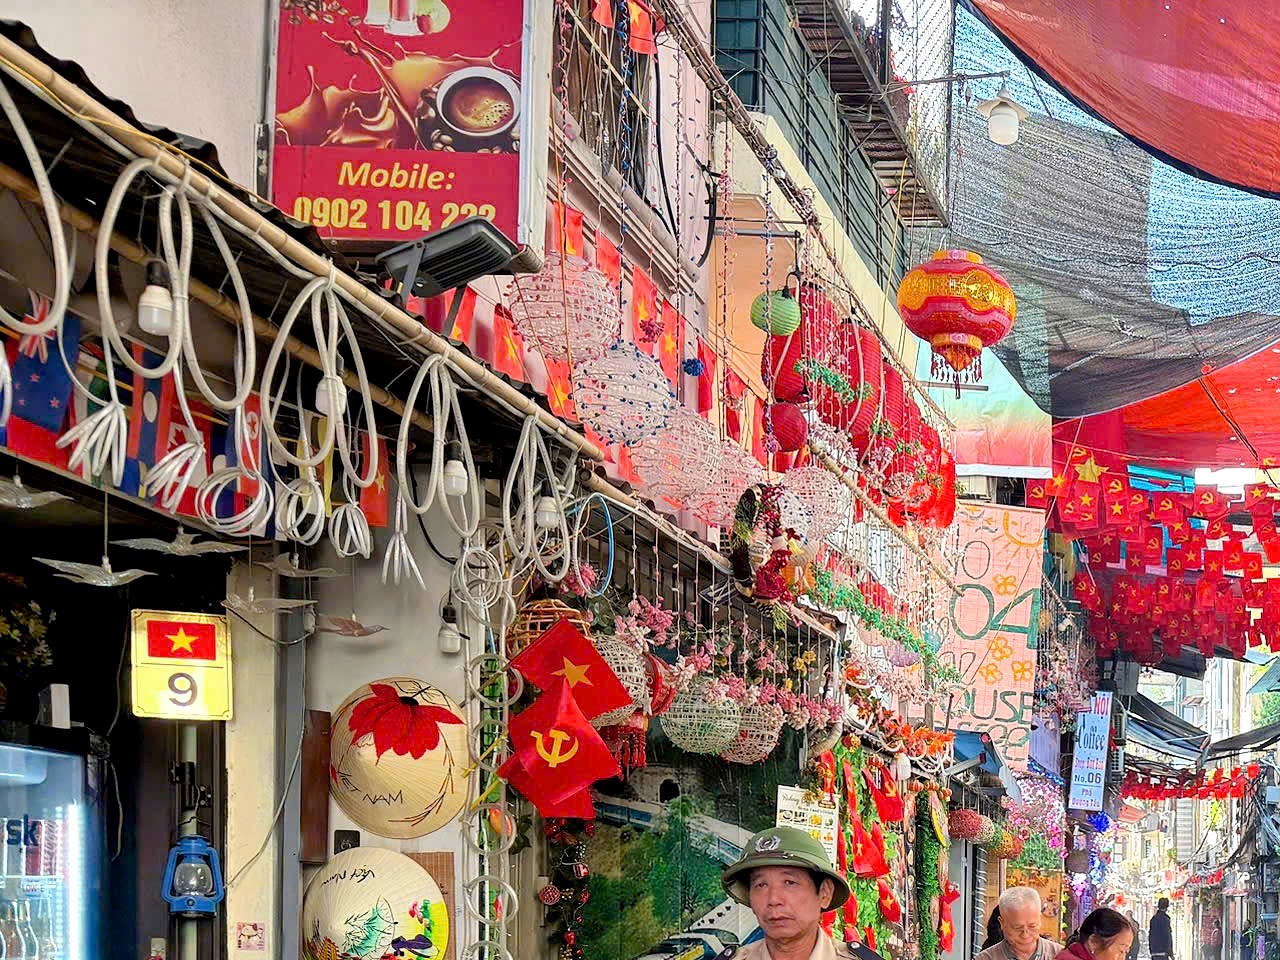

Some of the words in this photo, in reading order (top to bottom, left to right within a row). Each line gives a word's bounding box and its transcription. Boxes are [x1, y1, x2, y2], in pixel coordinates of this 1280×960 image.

[338, 162, 456, 190] Mobile:
[293, 196, 368, 230] 0902
[377, 200, 433, 232] 104
[948, 583, 1040, 650] 04
[167, 672, 199, 707] 9
[938, 685, 1034, 725] OUSE
[362, 789, 404, 806] NAM
